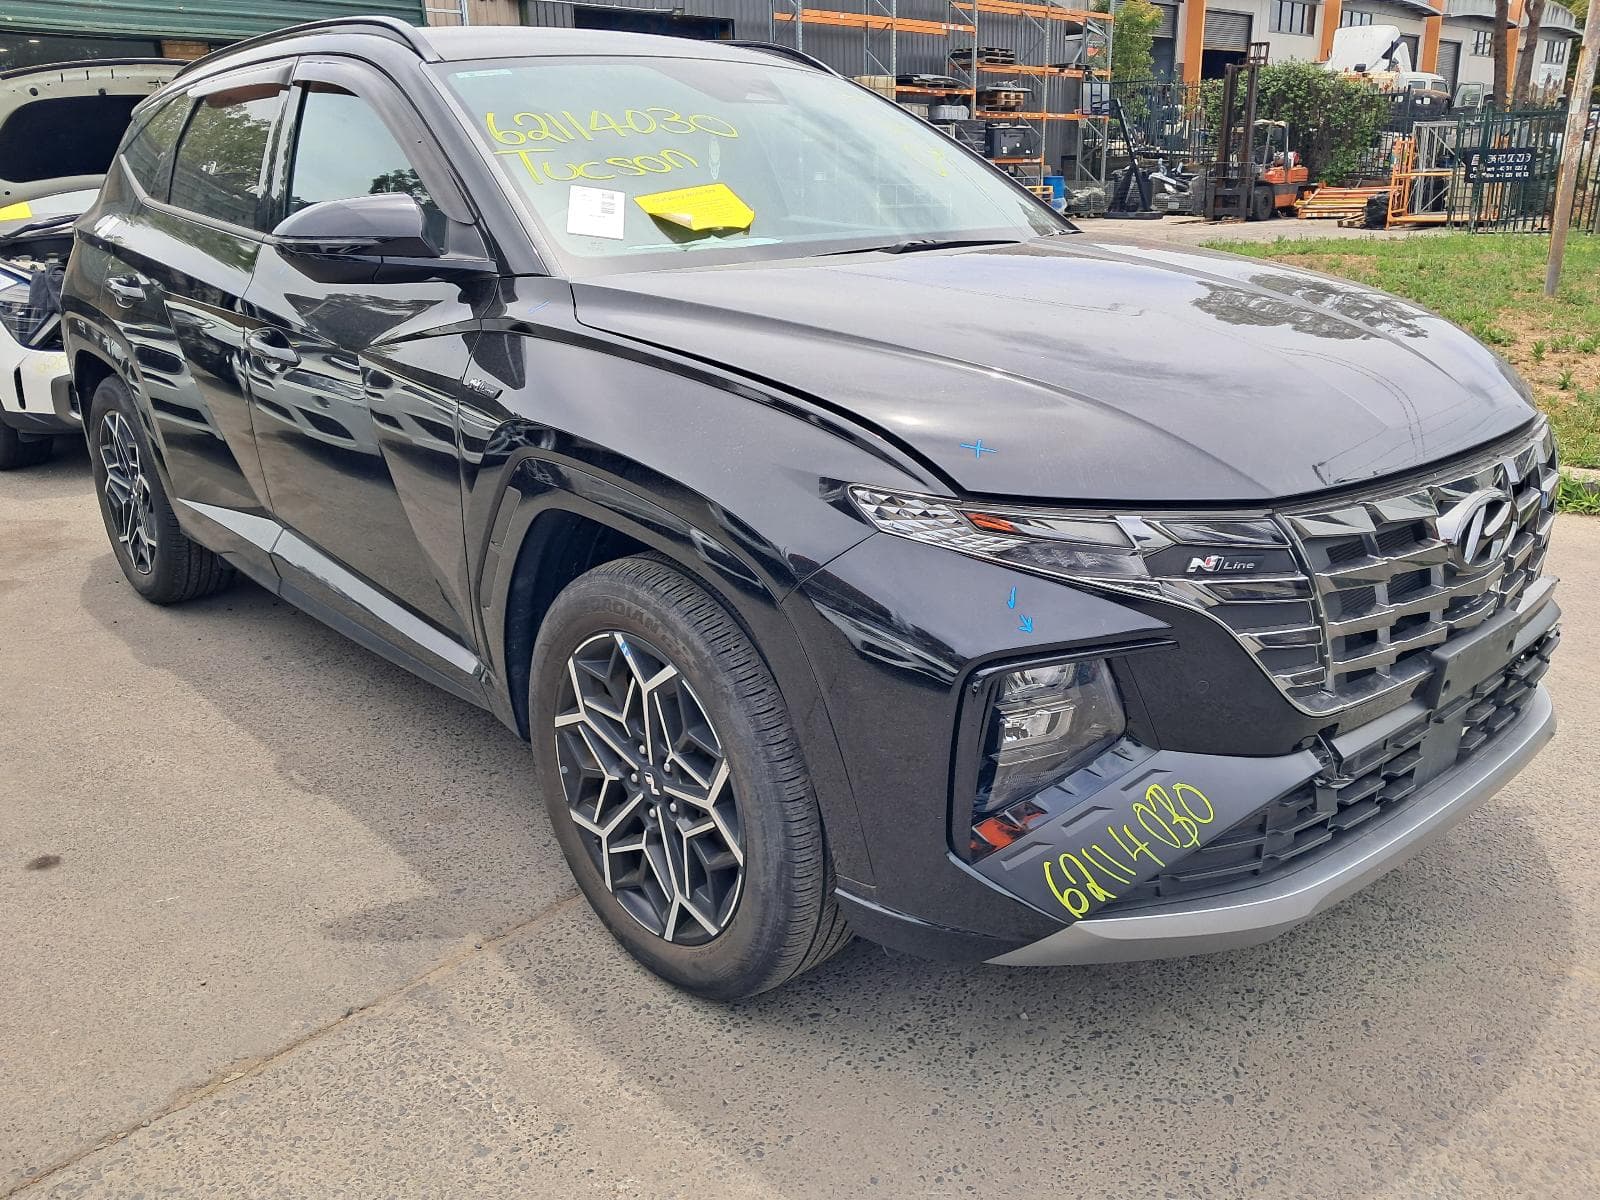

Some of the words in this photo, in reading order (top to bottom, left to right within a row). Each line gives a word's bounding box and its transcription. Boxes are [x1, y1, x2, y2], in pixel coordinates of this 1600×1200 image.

[486, 106, 739, 145] 62114030
[493, 148, 698, 185] Tucson
[1223, 561, 1256, 570] Line
[1043, 783, 1214, 919] 62114030
